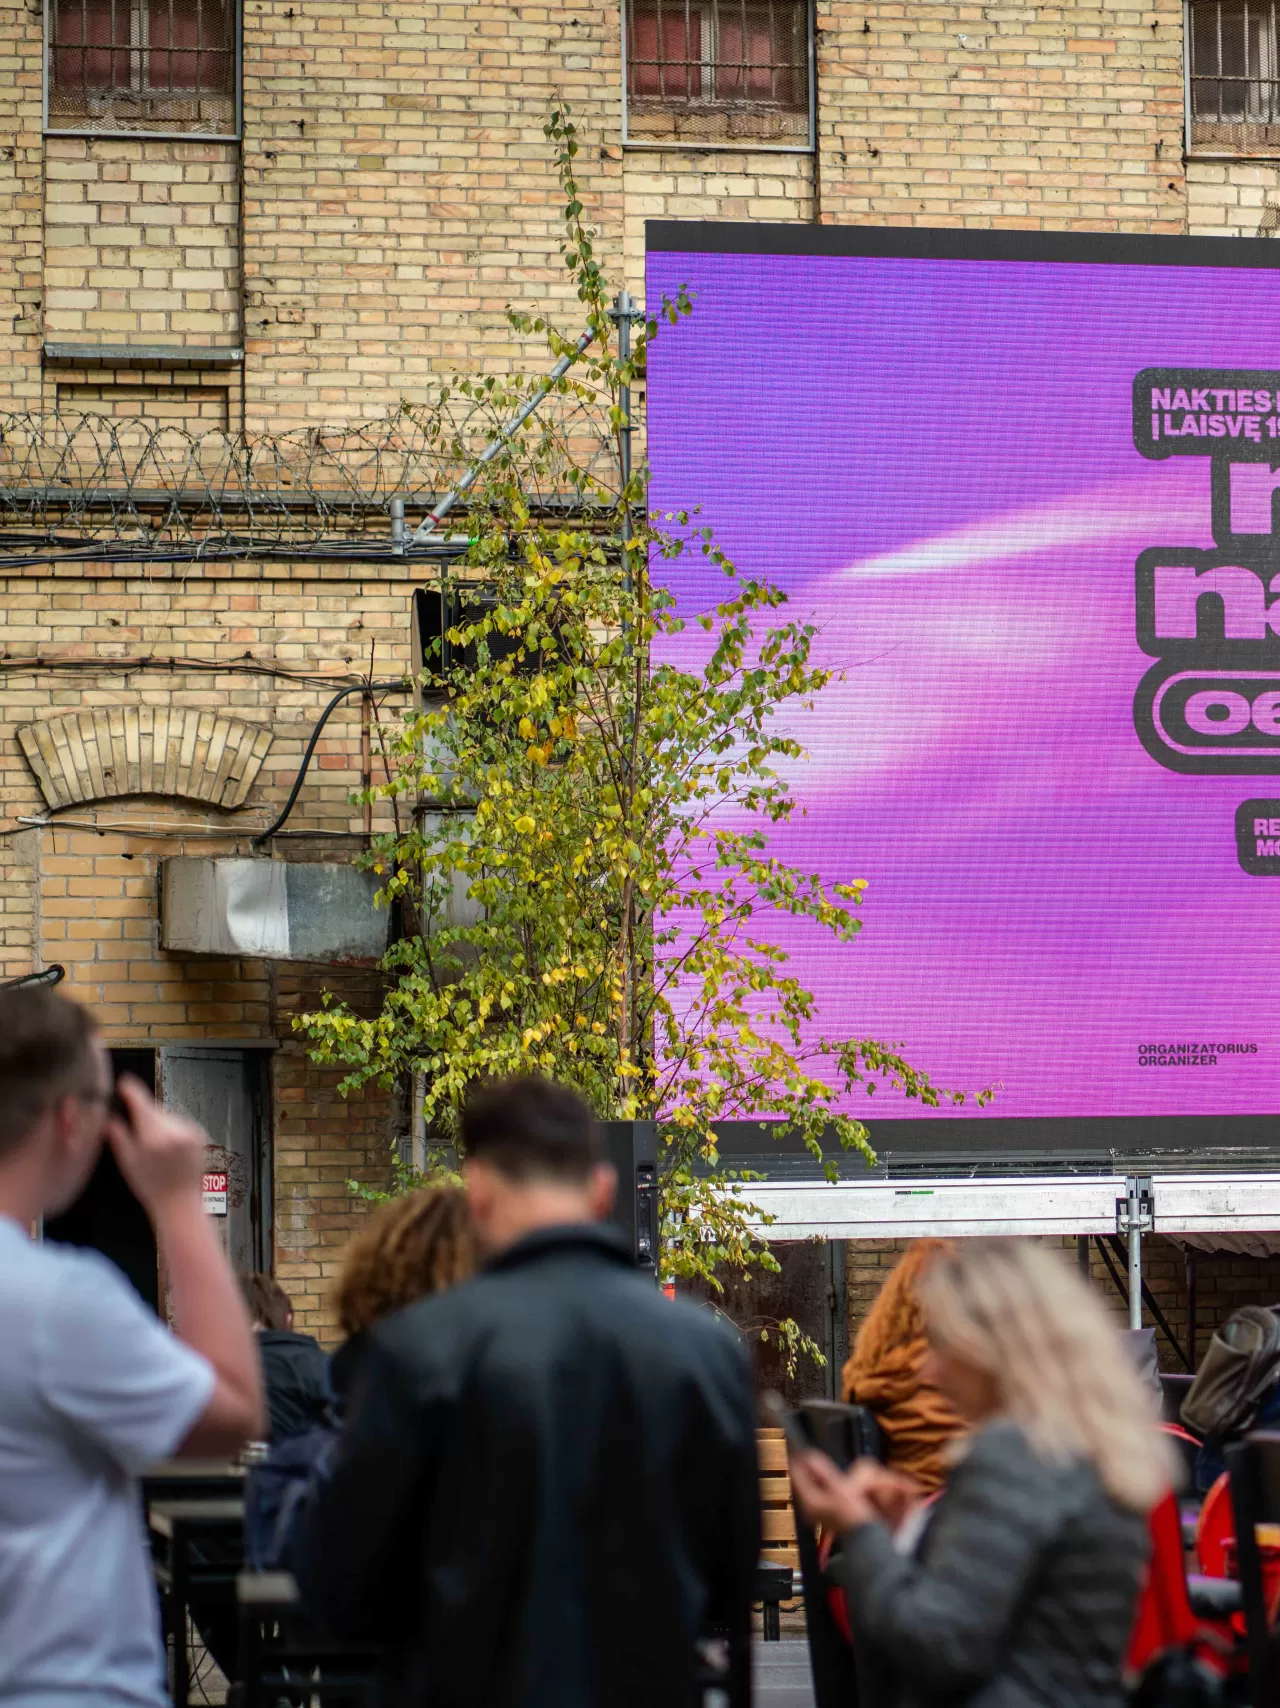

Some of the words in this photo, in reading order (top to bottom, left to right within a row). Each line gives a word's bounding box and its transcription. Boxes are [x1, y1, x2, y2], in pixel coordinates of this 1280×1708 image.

[1151, 387, 1272, 412] NAKTIES
[1163, 413, 1262, 442] LAISVĘ
[1138, 1043, 1258, 1055] ORGANIZATORIUS
[1138, 1054, 1218, 1066] ORGANIZER
[203, 1175, 226, 1191] STOP
